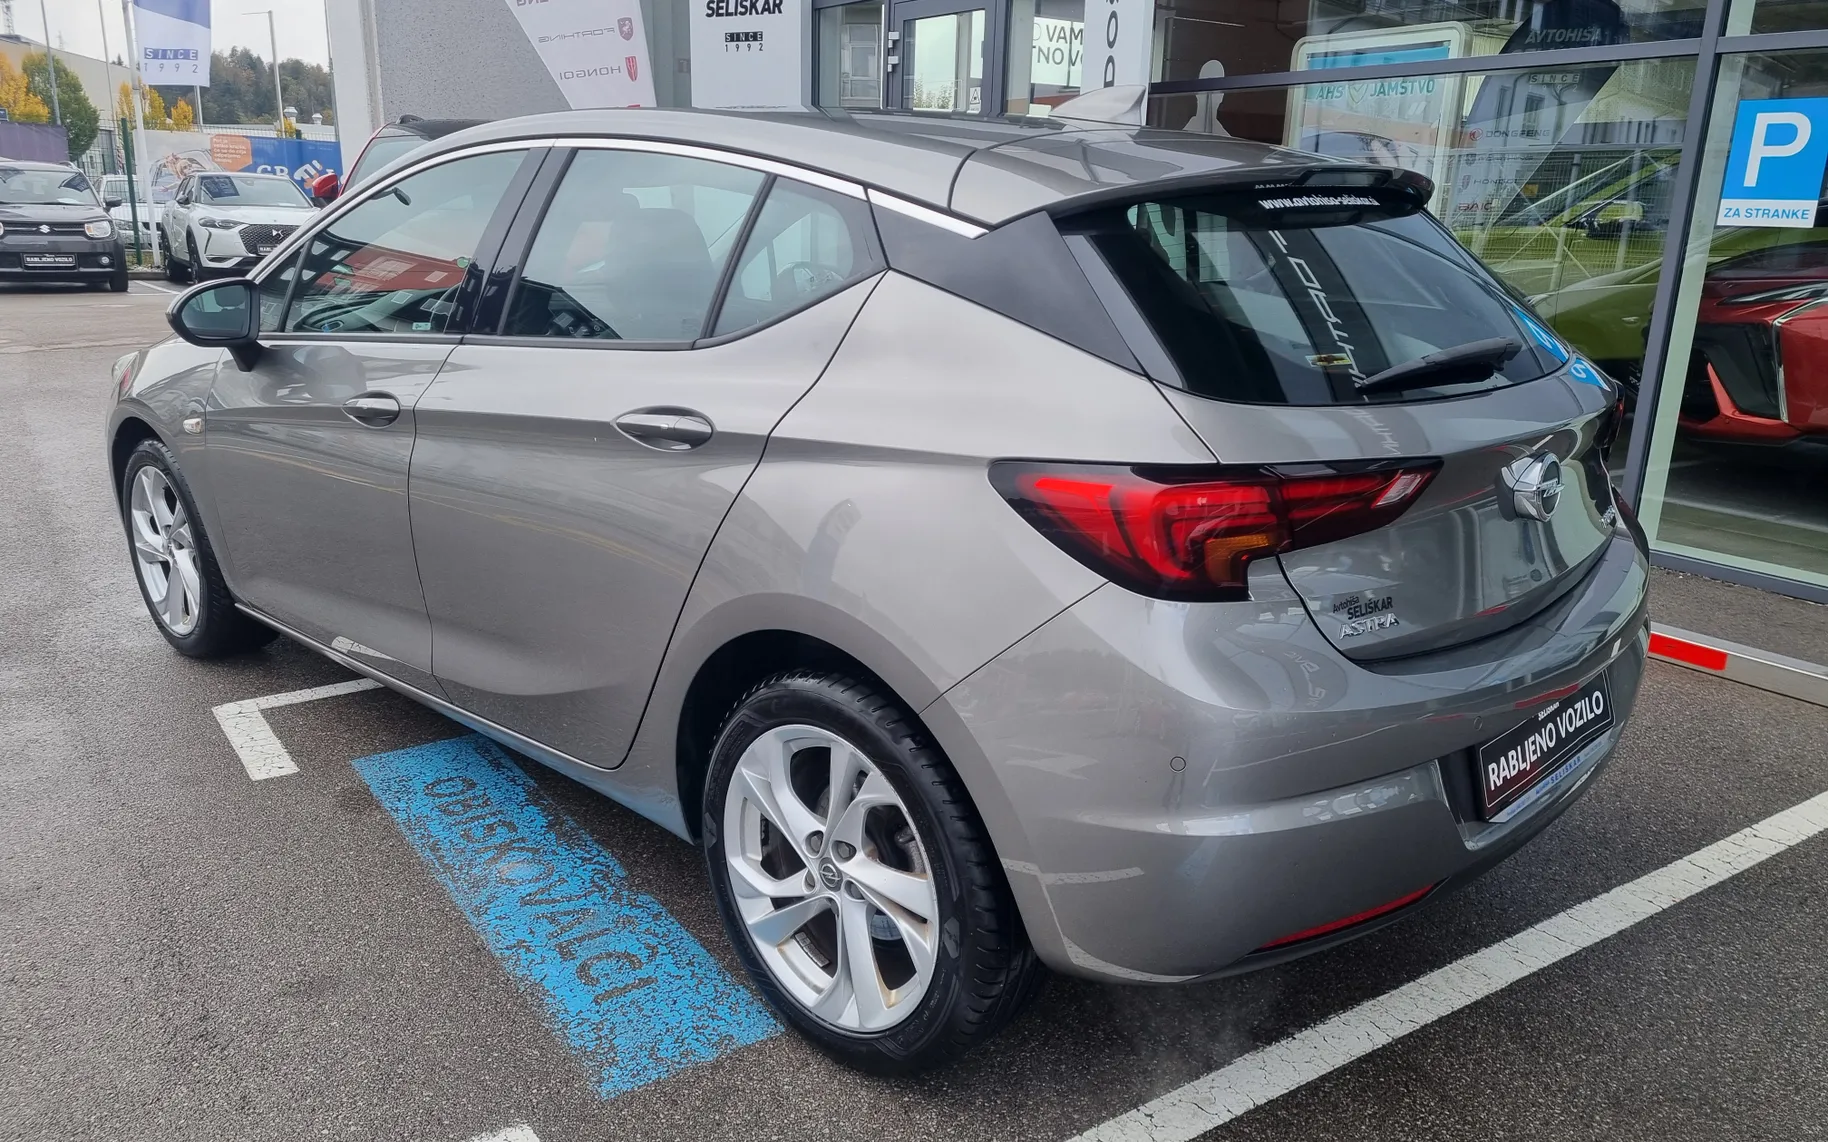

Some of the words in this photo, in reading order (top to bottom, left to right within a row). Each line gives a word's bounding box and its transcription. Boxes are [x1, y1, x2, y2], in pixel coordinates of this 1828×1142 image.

[725, 31, 763, 42] SINCE
[1046, 24, 1084, 45] VAM
[725, 43, 763, 52] 1992
[145, 49, 197, 60] SINCE
[144, 62, 198, 73] 1992
[1530, 74, 1579, 83] SINCE
[1316, 85, 1345, 100] AHS
[1370, 79, 1435, 97] JAMSTVO
[1743, 112, 1811, 187] P
[1724, 208, 1740, 218] ZA
[1745, 208, 1810, 220] STRANKE
[1340, 613, 1399, 640] ASTRA
[1488, 722, 1556, 791] RABLJENO
[1557, 691, 1604, 738] VOZILO
